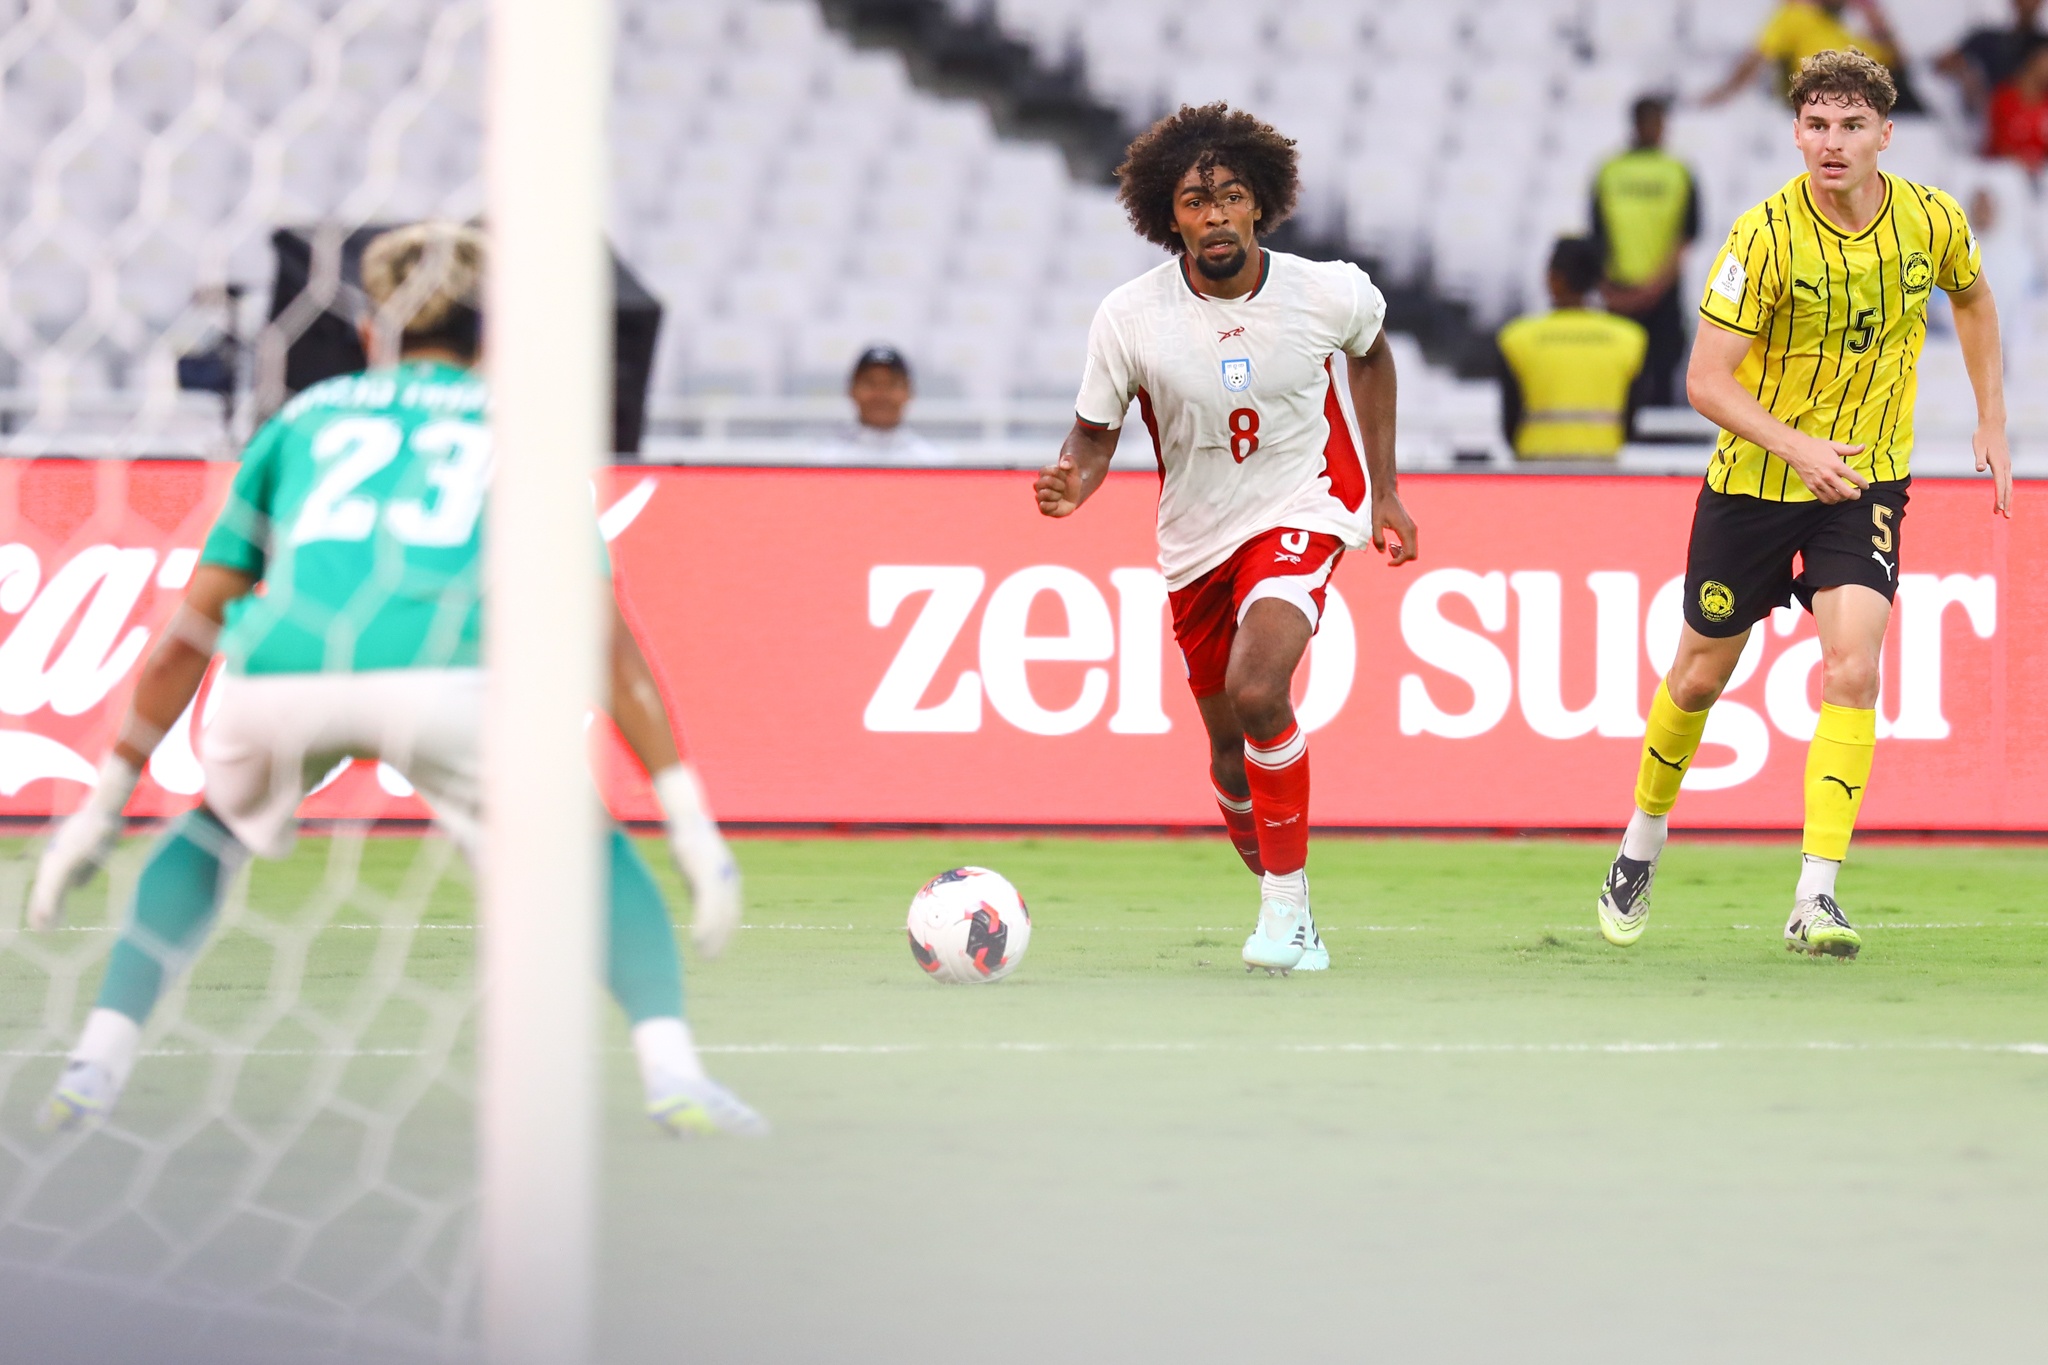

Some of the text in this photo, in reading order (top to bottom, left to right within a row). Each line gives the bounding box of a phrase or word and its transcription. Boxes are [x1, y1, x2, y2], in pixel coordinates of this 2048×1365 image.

[1847, 307, 1878, 354] 5
[1229, 408, 1260, 464] 8
[289, 415, 492, 548] 23
[1872, 503, 1893, 553] 5
